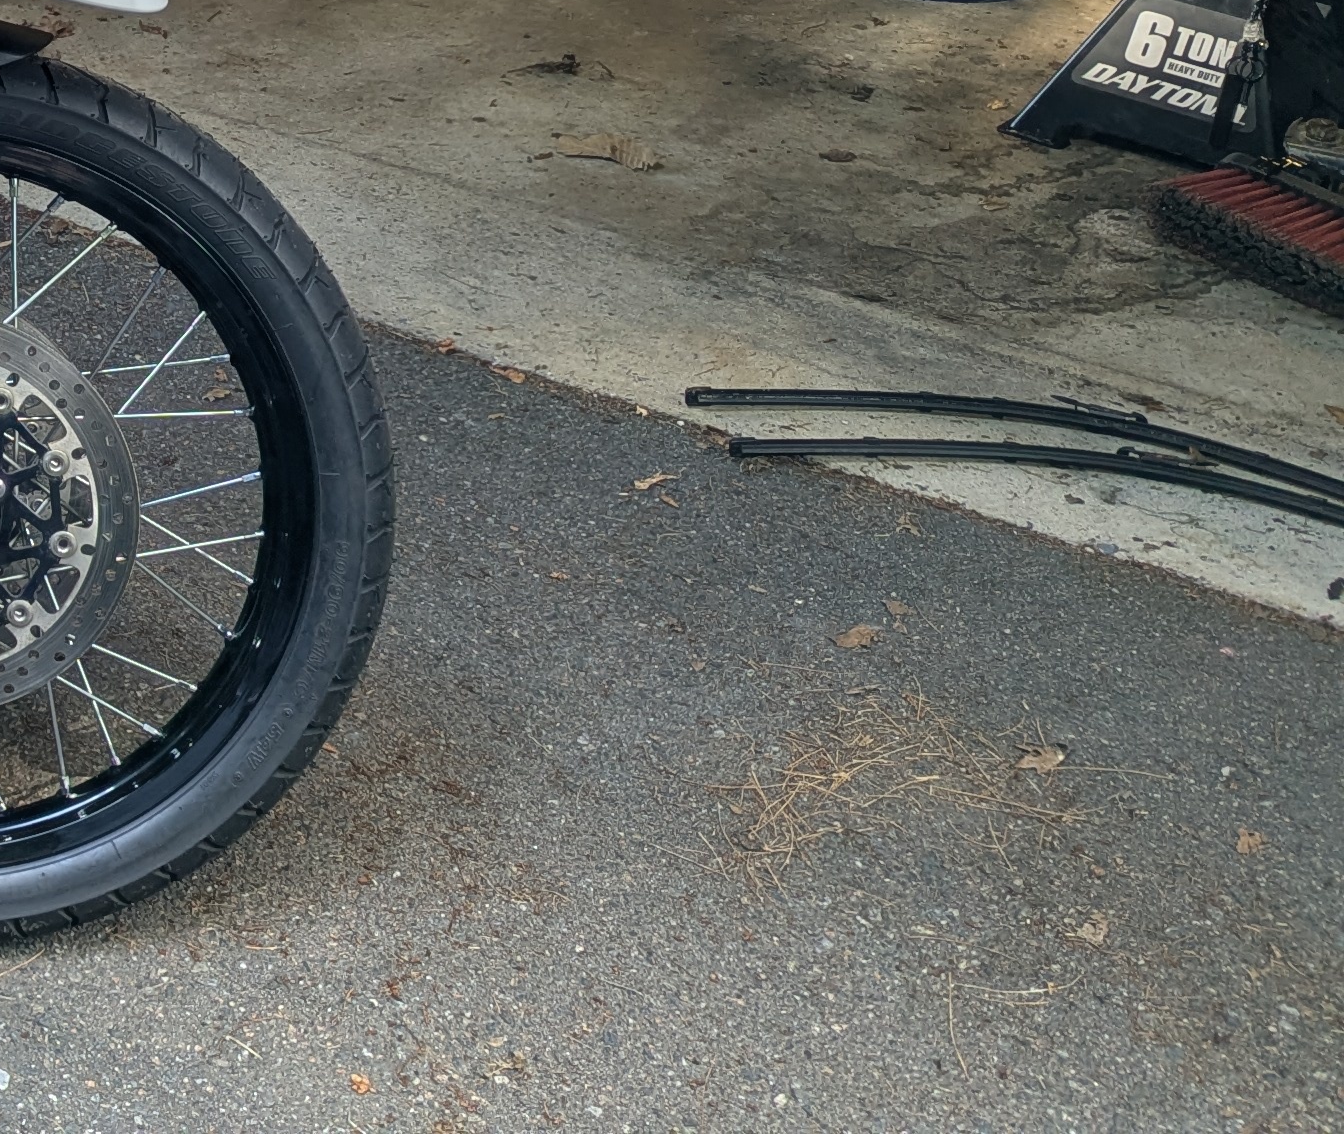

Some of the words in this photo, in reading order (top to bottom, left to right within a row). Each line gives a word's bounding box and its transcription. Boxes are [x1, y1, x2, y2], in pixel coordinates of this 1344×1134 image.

[1124, 10, 1175, 68] 6
[1173, 26, 1238, 69] TON
[1167, 60, 1196, 78] HEAVY
[1197, 69, 1222, 84] DUTY
